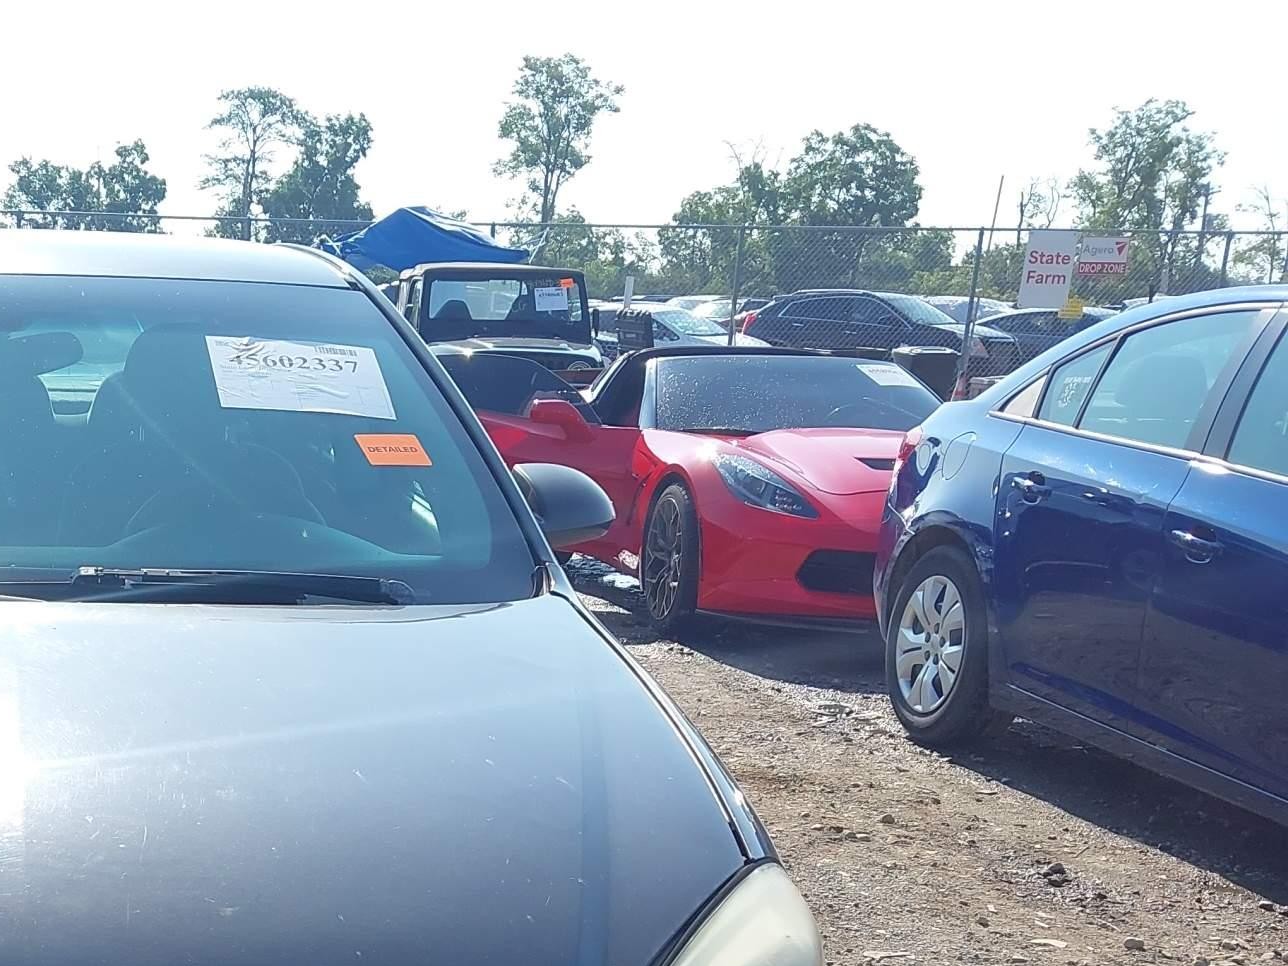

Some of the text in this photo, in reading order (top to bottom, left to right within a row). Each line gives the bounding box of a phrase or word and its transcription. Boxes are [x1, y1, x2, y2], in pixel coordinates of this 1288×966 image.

[1028, 250, 1071, 265] State
[1079, 263, 1126, 274] DROP ZONE
[1026, 270, 1067, 285] Farm
[228, 353, 358, 374] 45602337
